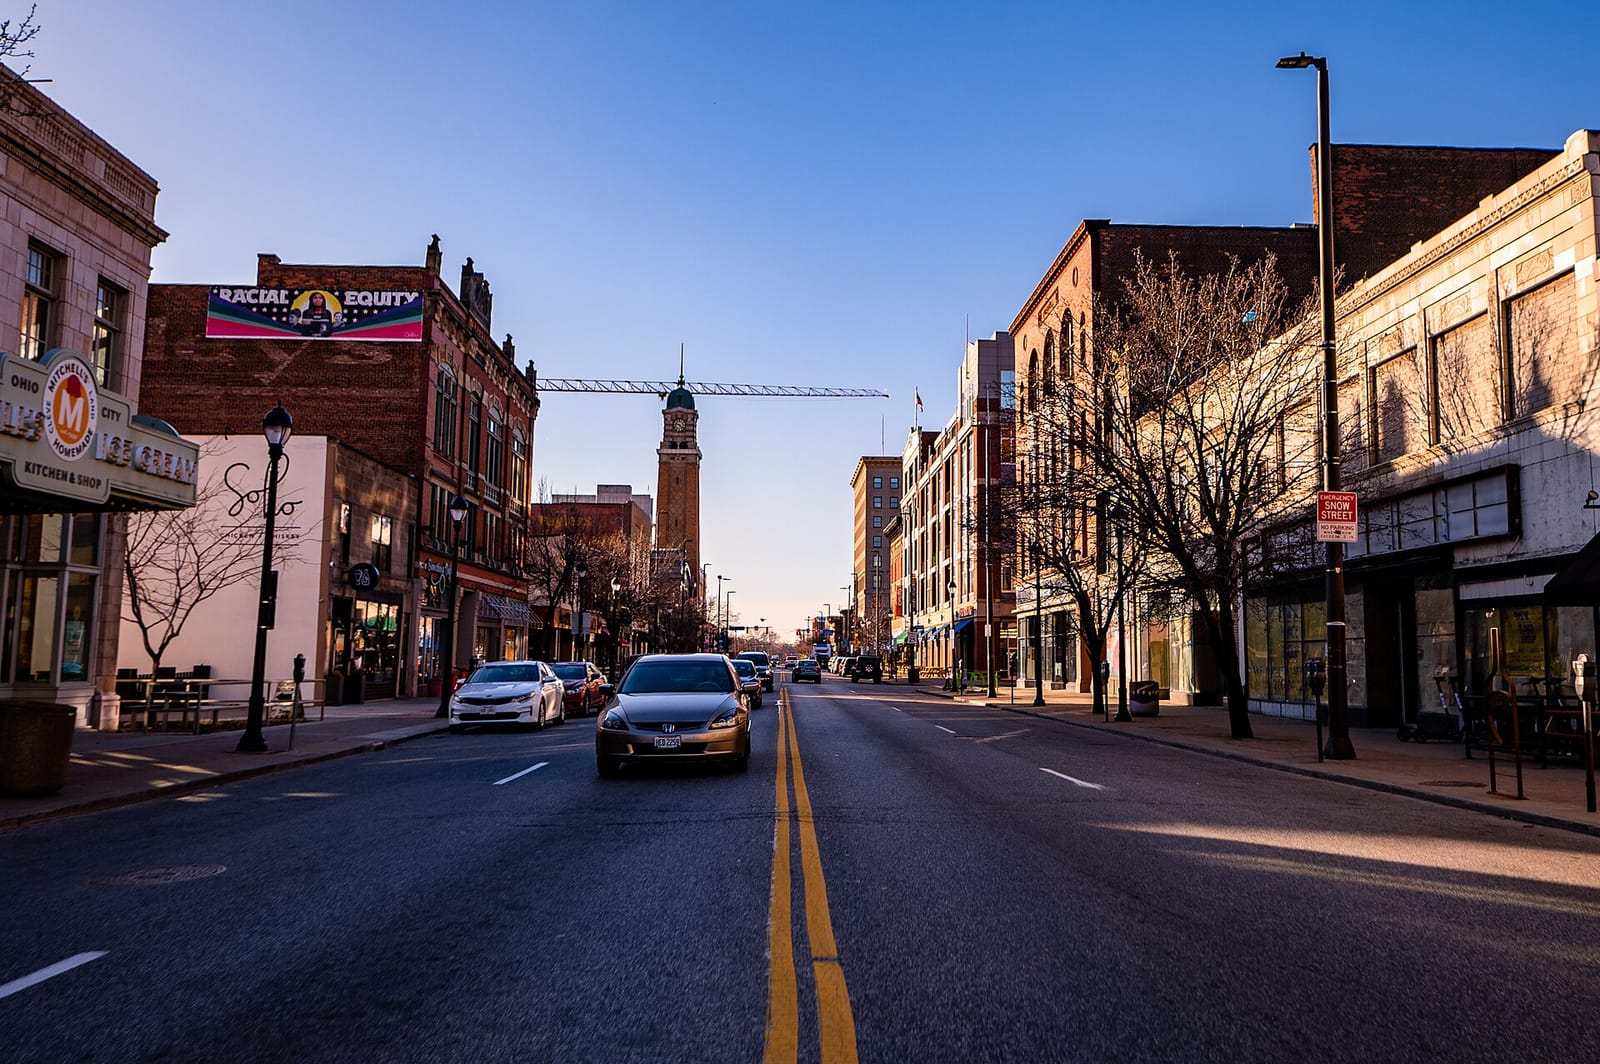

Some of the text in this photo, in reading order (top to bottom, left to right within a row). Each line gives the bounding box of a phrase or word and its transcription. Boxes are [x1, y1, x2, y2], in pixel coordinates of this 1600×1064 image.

[219, 288, 419, 307] RACIAL EQUITY
[11, 374, 39, 394] OHIO
[48, 363, 88, 392] MITCHELL'S
[46, 400, 54, 434] CLEVE
[58, 389, 84, 433] M
[101, 407, 122, 422] CITY
[53, 428, 93, 458] HOMEMADE
[97, 433, 132, 467] ICE
[24, 461, 102, 489] KITCHEN & SHOP
[1321, 511, 1352, 520] STREET
[1324, 501, 1350, 510] SNOW
